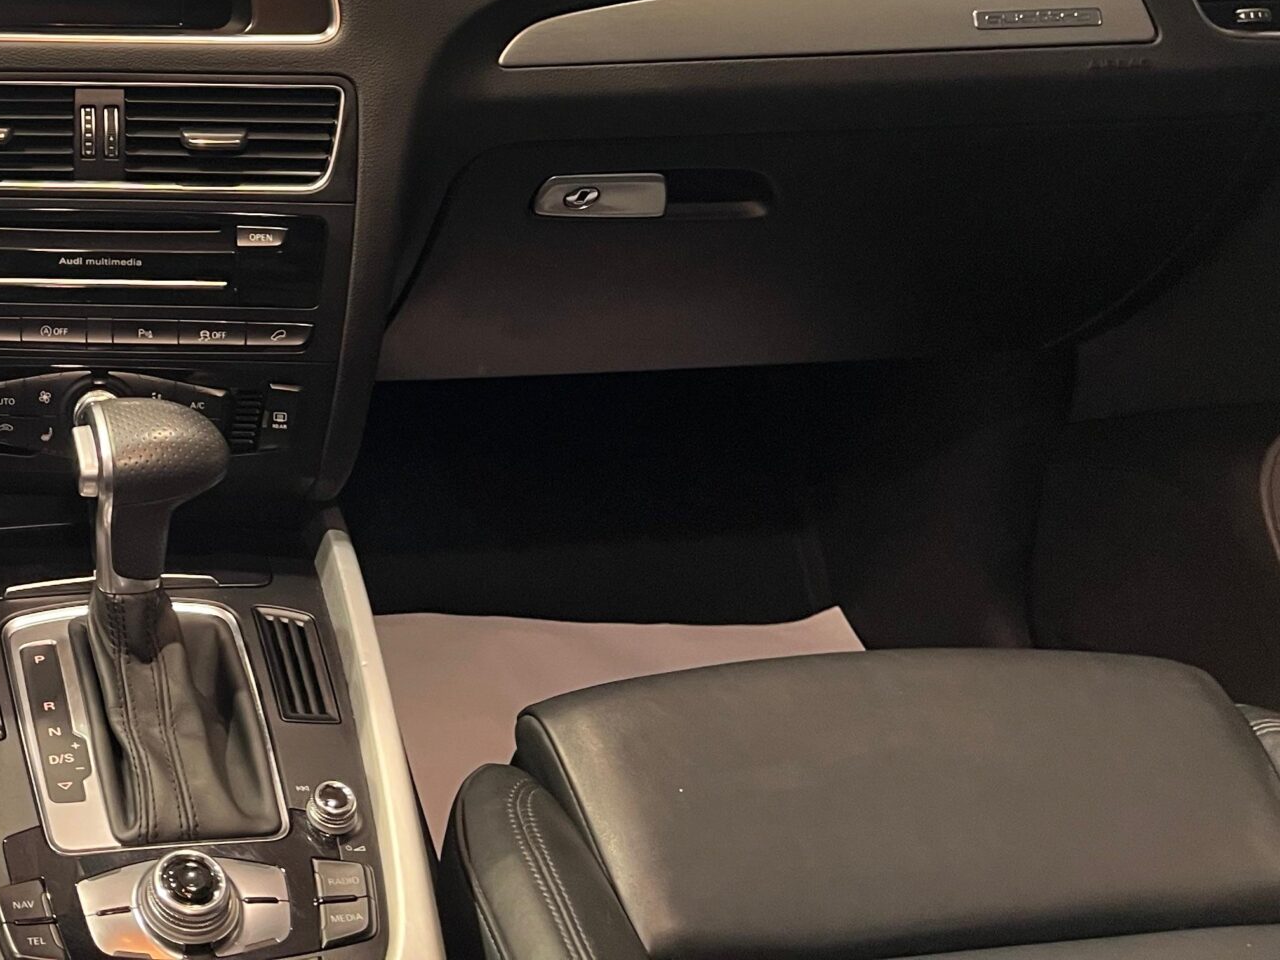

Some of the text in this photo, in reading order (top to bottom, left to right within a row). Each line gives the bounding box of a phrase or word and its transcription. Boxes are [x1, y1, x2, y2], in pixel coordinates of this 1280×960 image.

[248, 233, 273, 242] OPEN
[58, 257, 143, 267] Audi multimedia
[53, 327, 68, 336] OFF
[211, 331, 227, 340] OFF
[190, 401, 205, 410] A/C
[34, 654, 46, 665] P
[43, 701, 56, 711] R
[48, 726, 62, 737] N
[48, 752, 75, 766] D/S
[327, 875, 361, 887] RADIO
[12, 900, 35, 910] NAV
[330, 913, 364, 925] MEDIA
[27, 936, 47, 946] TEL
